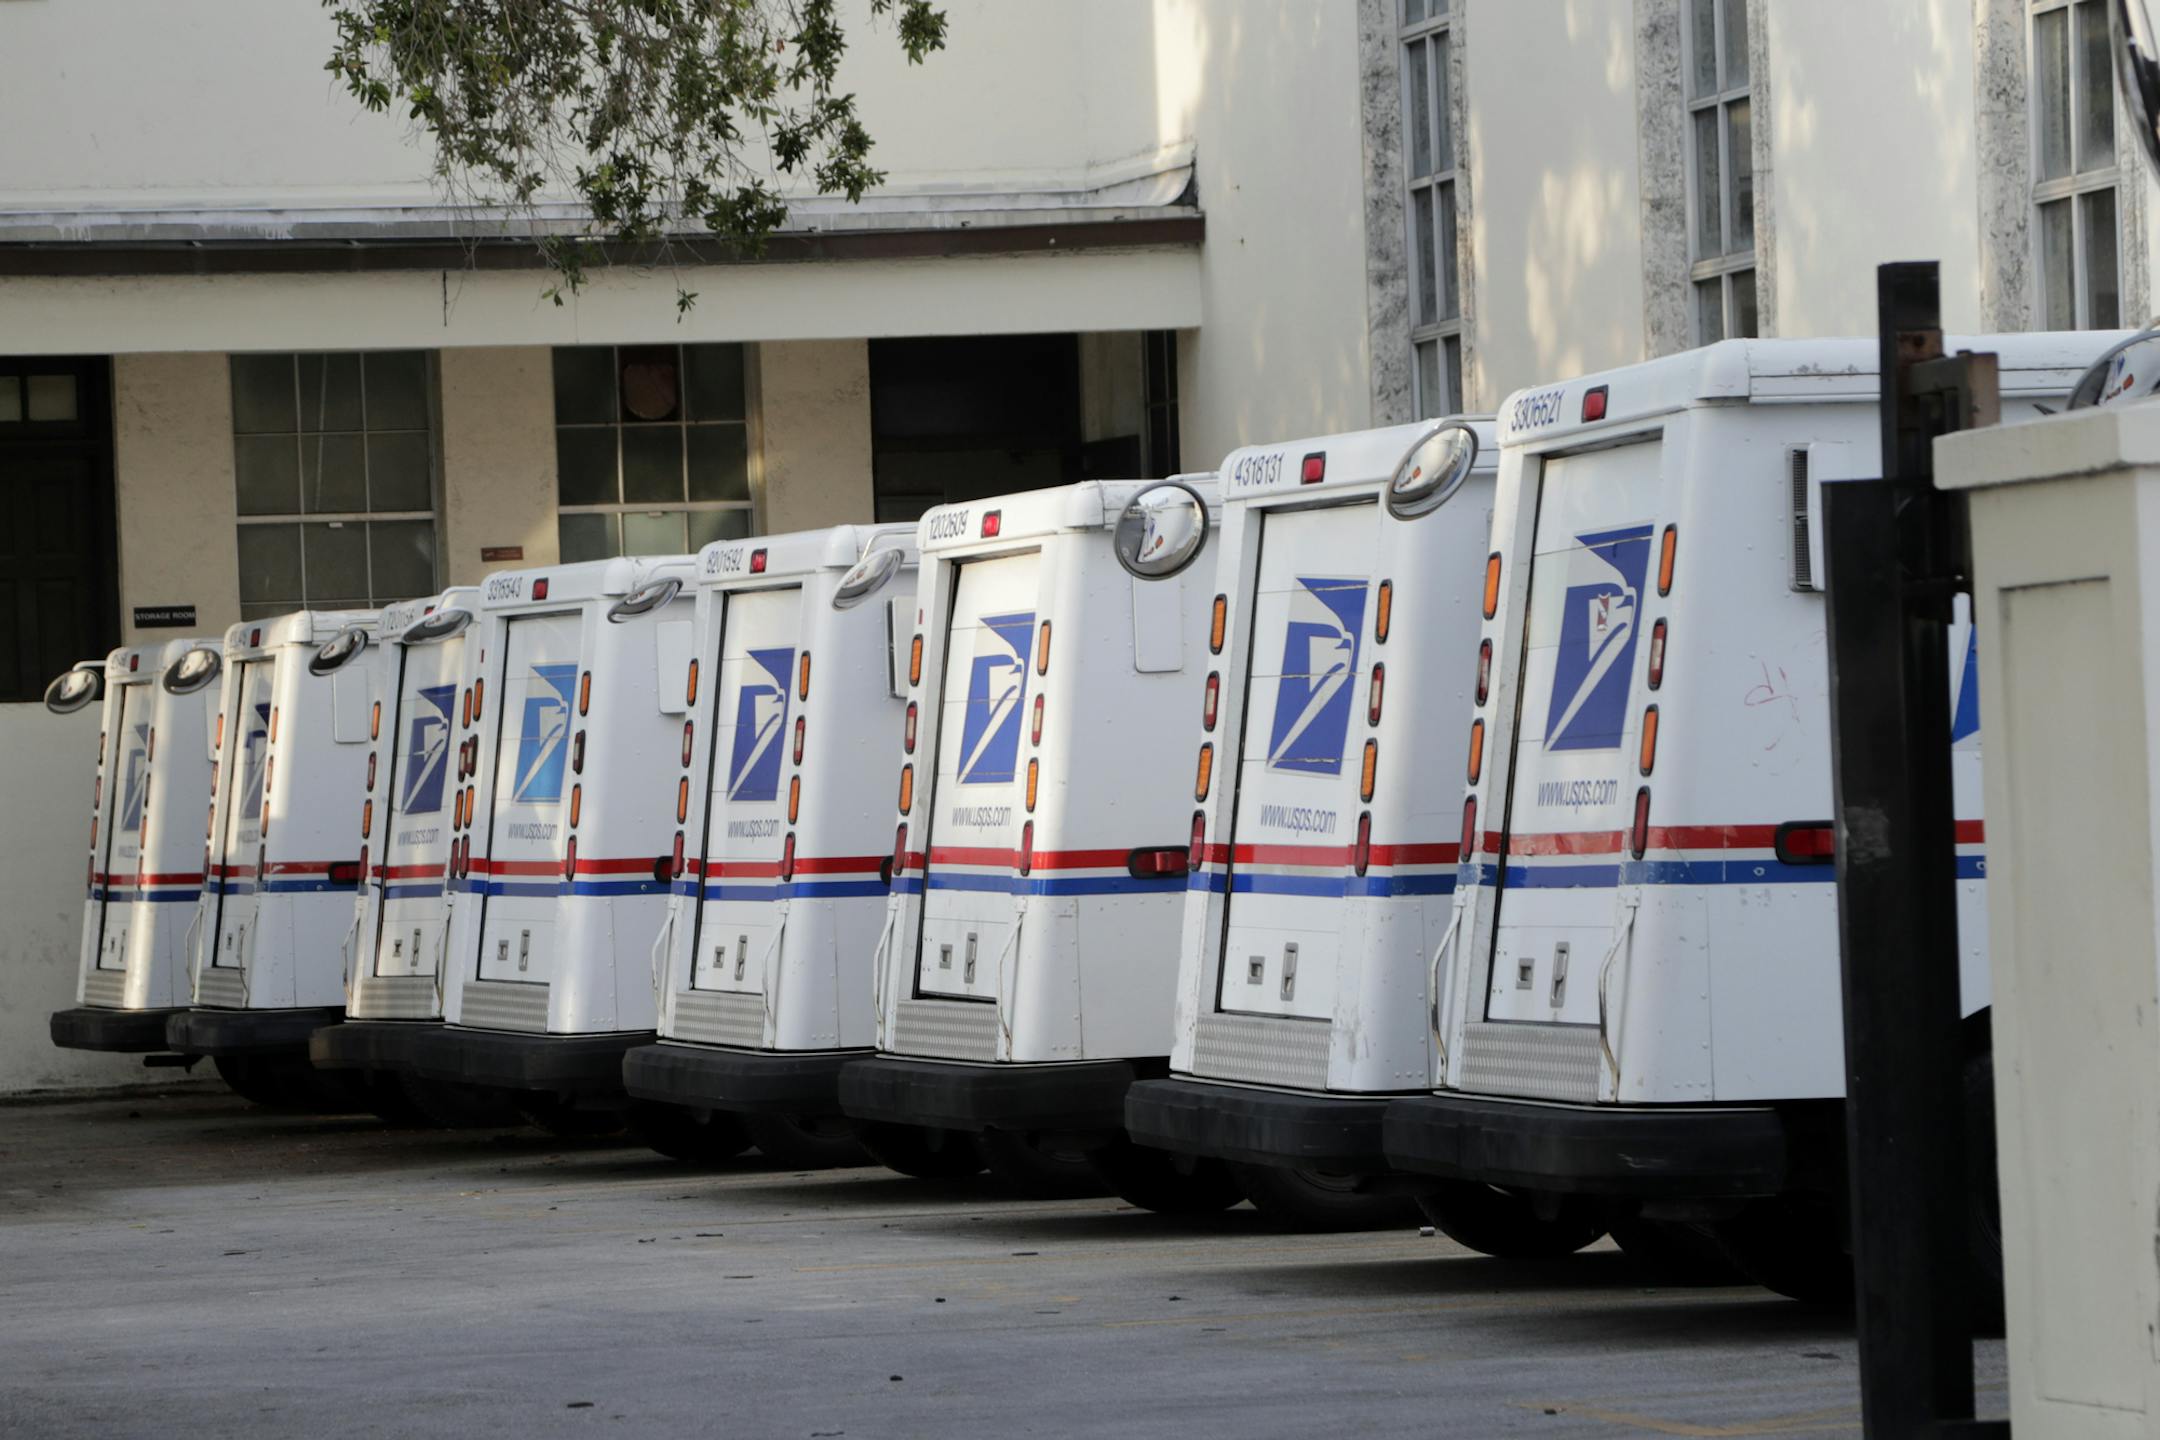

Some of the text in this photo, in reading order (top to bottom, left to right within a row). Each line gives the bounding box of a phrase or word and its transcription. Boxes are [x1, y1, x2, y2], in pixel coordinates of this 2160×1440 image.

[1511, 389, 1565, 432] 3306621
[1235, 452, 1285, 486] 4318131
[929, 509, 969, 539] 1202609
[135, 611, 196, 621] STORAGE ROOM
[1537, 779, 1618, 815] www.usps.com
[508, 823, 558, 845] www.usps.com
[728, 818, 780, 845] www.usps.com
[952, 806, 1011, 833] www.usps.com
[1260, 803, 1337, 837] www.usps.com
